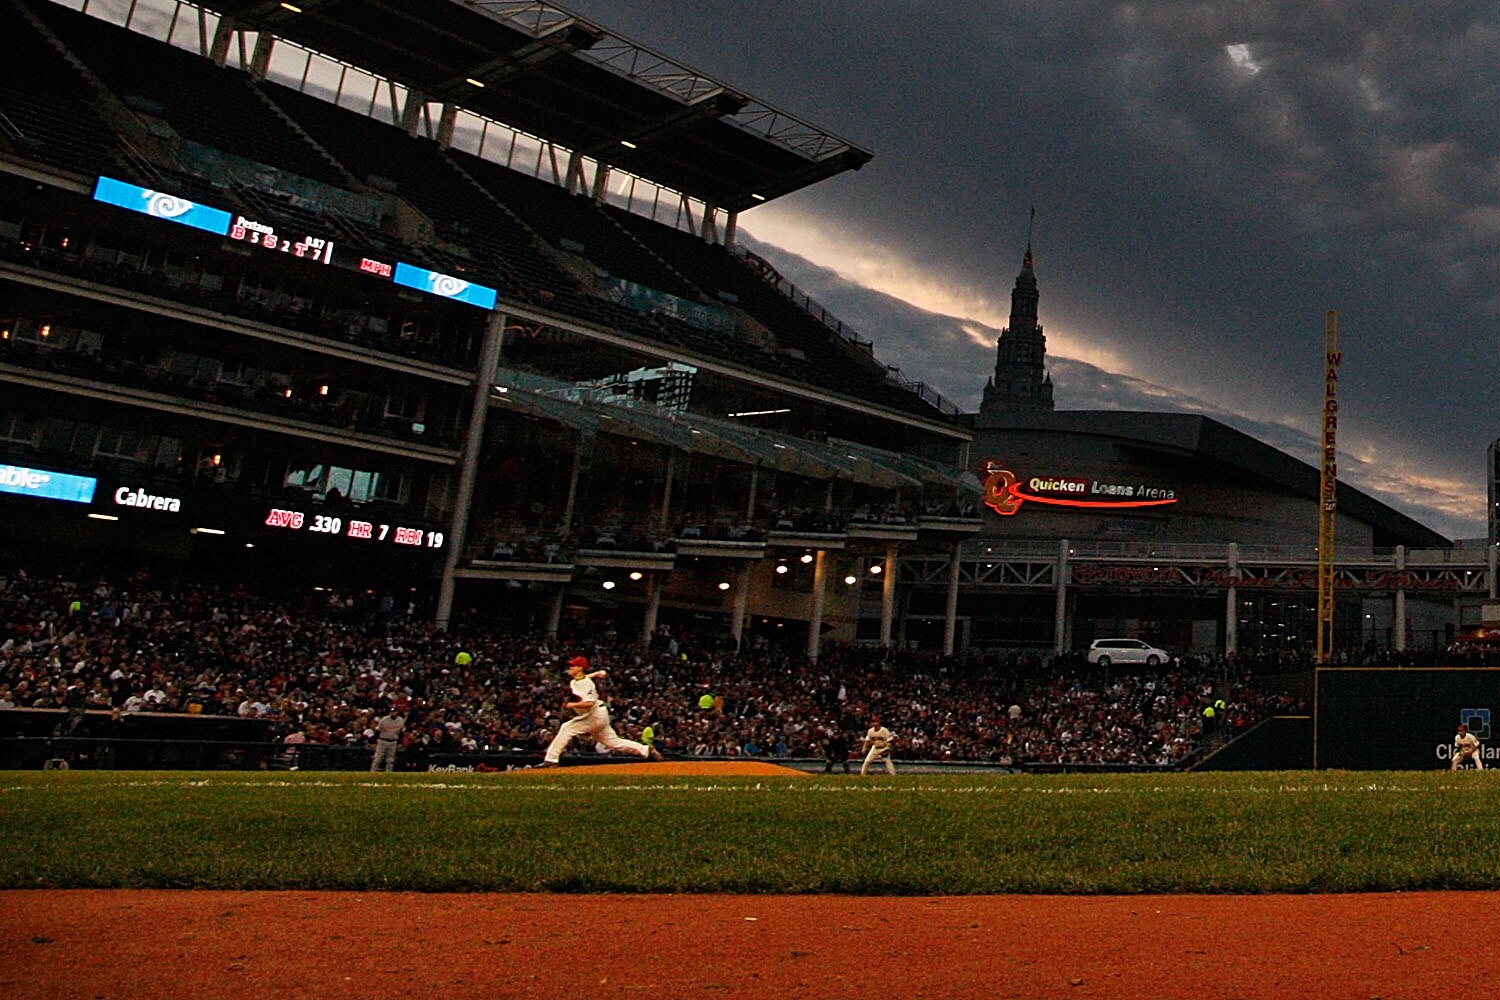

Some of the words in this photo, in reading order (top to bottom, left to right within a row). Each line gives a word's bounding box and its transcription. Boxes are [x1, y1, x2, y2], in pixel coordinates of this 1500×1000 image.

[237, 215, 274, 235] Pestano
[231, 224, 246, 240] B
[249, 232, 260, 244] 5
[262, 233, 279, 249] S
[281, 240, 291, 253] 2
[293, 241, 310, 258] T
[312, 248, 322, 260] 7
[359, 257, 393, 278] MPH
[115, 486, 181, 513] Cabrera
[1029, 477, 1085, 494] Quicken
[1091, 480, 1134, 497] Loans
[1136, 480, 1175, 500] Arena
[265, 508, 305, 529] AVG
[309, 515, 342, 534] .330
[346, 520, 373, 540] HR
[378, 524, 390, 542] 7
[393, 527, 425, 546] RBI
[426, 530, 444, 549] 19
